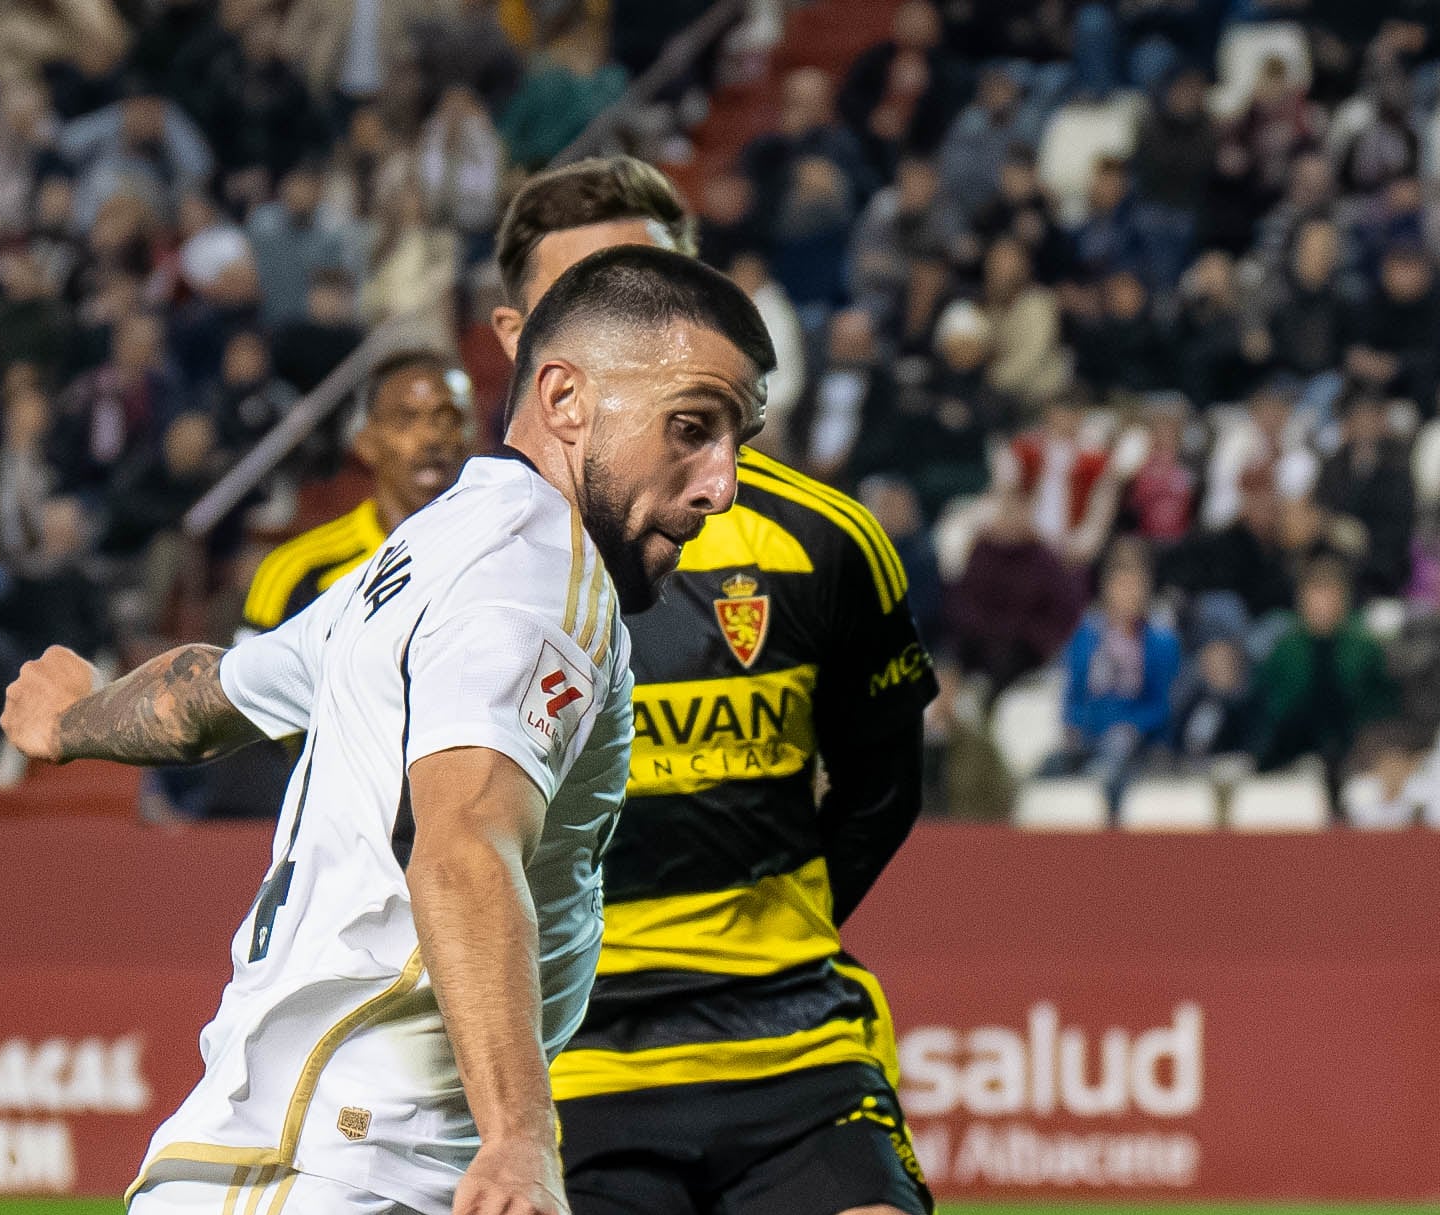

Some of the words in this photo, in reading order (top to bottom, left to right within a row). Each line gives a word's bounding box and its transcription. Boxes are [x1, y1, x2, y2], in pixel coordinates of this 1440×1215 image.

[633, 686, 794, 747] AVAN
[630, 744, 783, 781] NCIA
[896, 1001, 1205, 1118] salud
